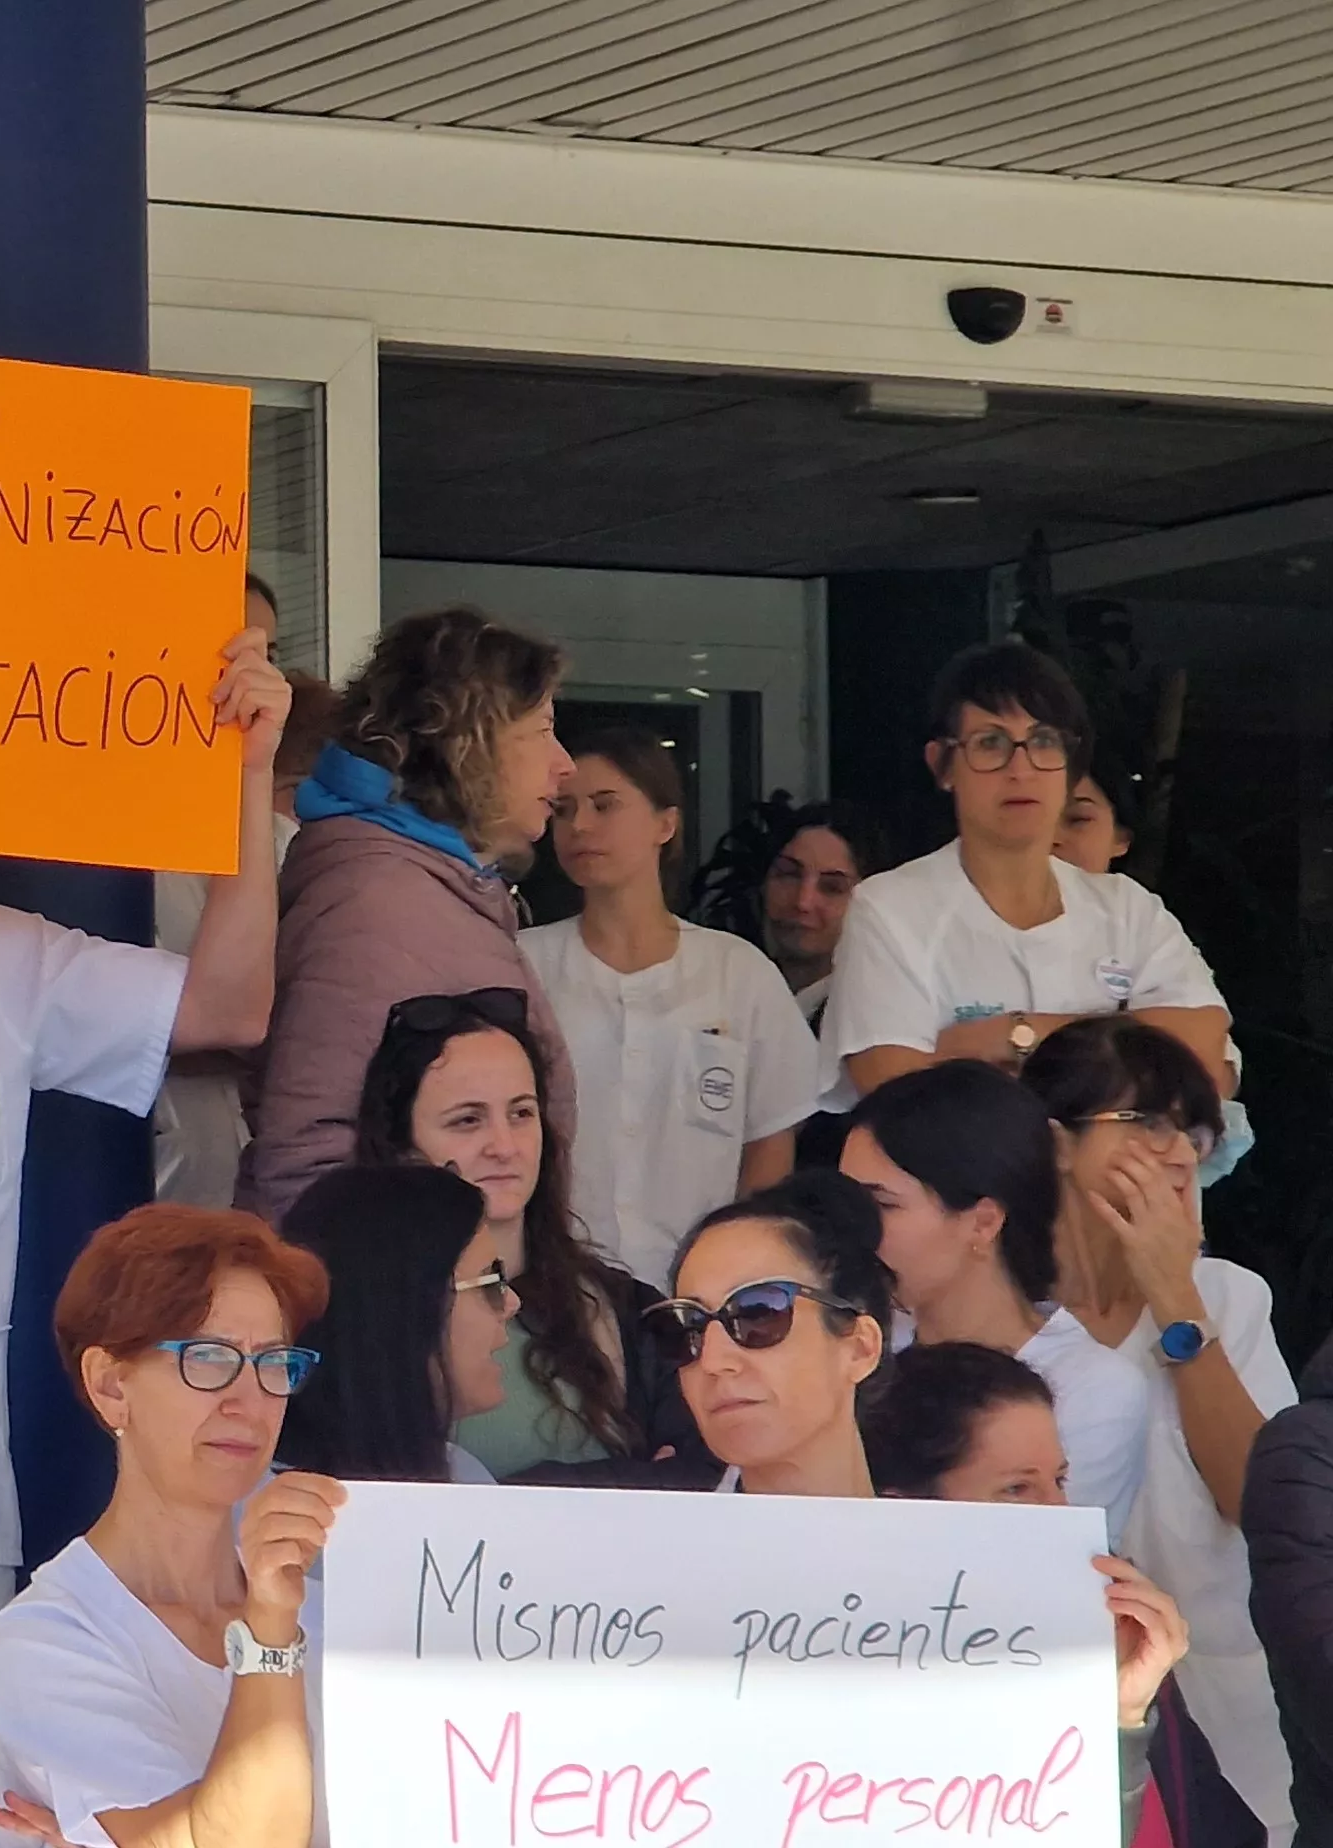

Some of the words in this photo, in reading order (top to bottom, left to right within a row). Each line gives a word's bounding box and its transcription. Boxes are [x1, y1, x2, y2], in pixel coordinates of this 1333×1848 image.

[416, 1538, 665, 1667] Mismos
[733, 1570, 1041, 1699] pacientes
[445, 1712, 712, 1848] Menos
[782, 1726, 1083, 1848] personal
